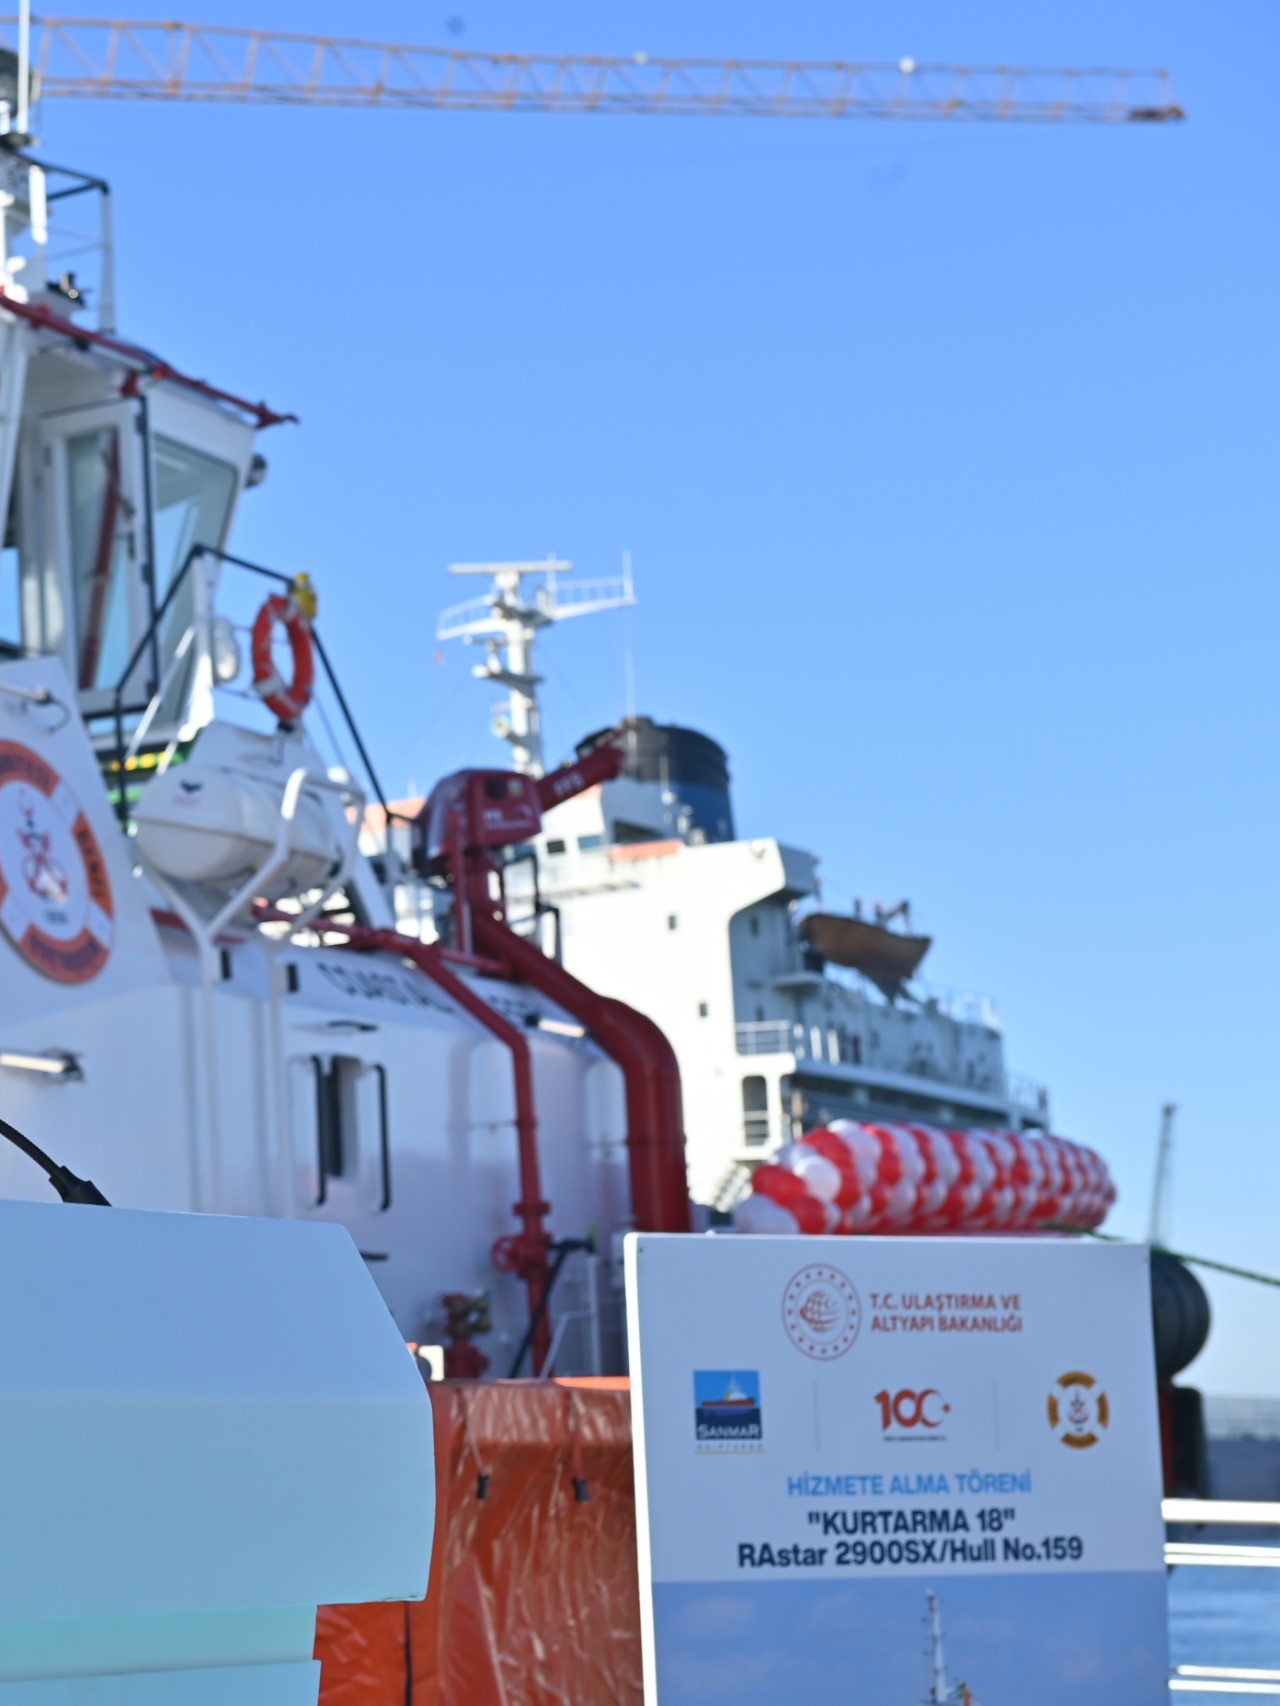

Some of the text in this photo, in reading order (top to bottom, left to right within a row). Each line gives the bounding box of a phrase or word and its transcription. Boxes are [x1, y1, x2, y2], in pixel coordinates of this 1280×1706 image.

[870, 1293, 1021, 1313] T.C. ULAŞTIRMA VE
[871, 1312, 1022, 1332] ALTYAPI BAKANLIĞI
[787, 1468, 1032, 1497] HİZMETE ALMA TÖRENİ
[808, 1507, 1015, 1535] "KURTARMA 18"
[738, 1536, 1083, 1568] RAstar 2900SX/Hull No.159
